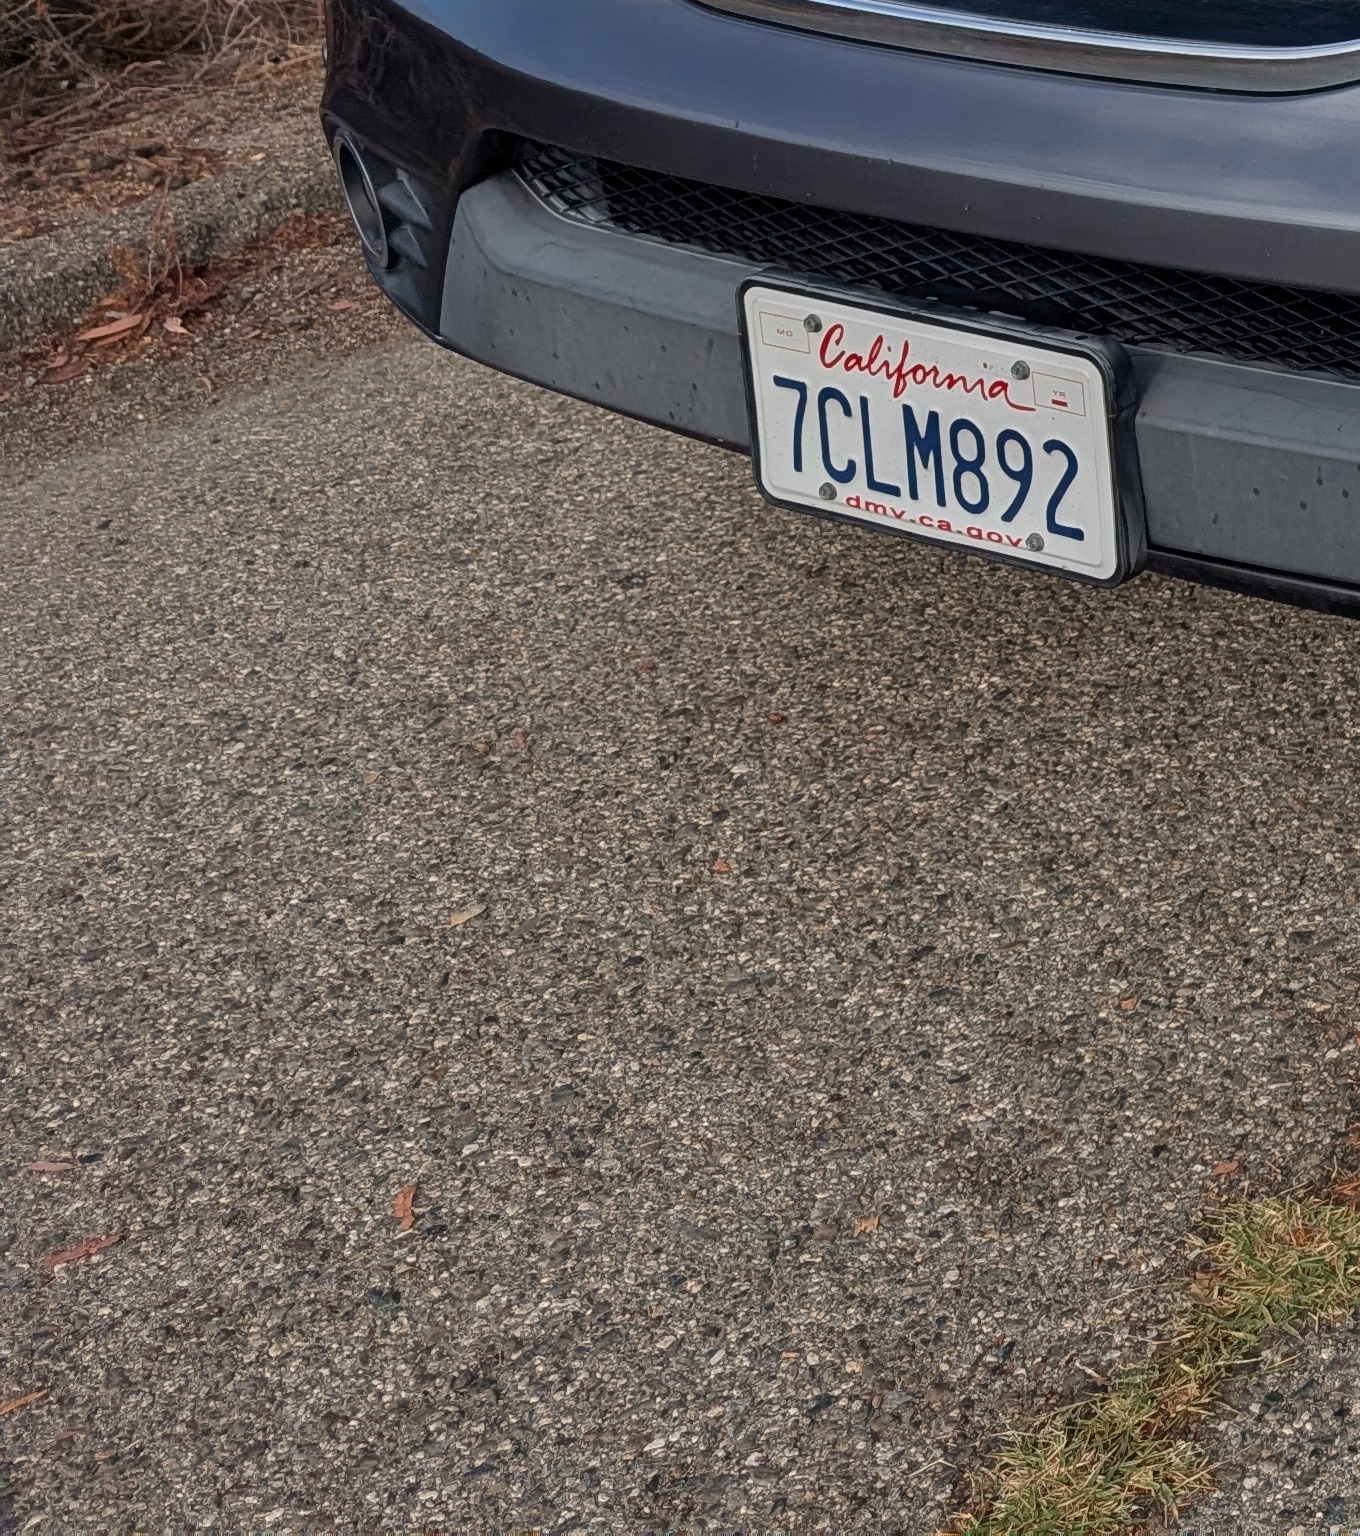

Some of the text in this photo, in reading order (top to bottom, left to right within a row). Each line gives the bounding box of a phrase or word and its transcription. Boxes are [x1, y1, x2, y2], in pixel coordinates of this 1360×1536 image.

[776, 328, 794, 338] MO
[818, 322, 1037, 412] California
[1052, 389, 1066, 398] YR
[772, 374, 1085, 542] 7CLM892
[844, 493, 1024, 549] dmv.ca.gov
